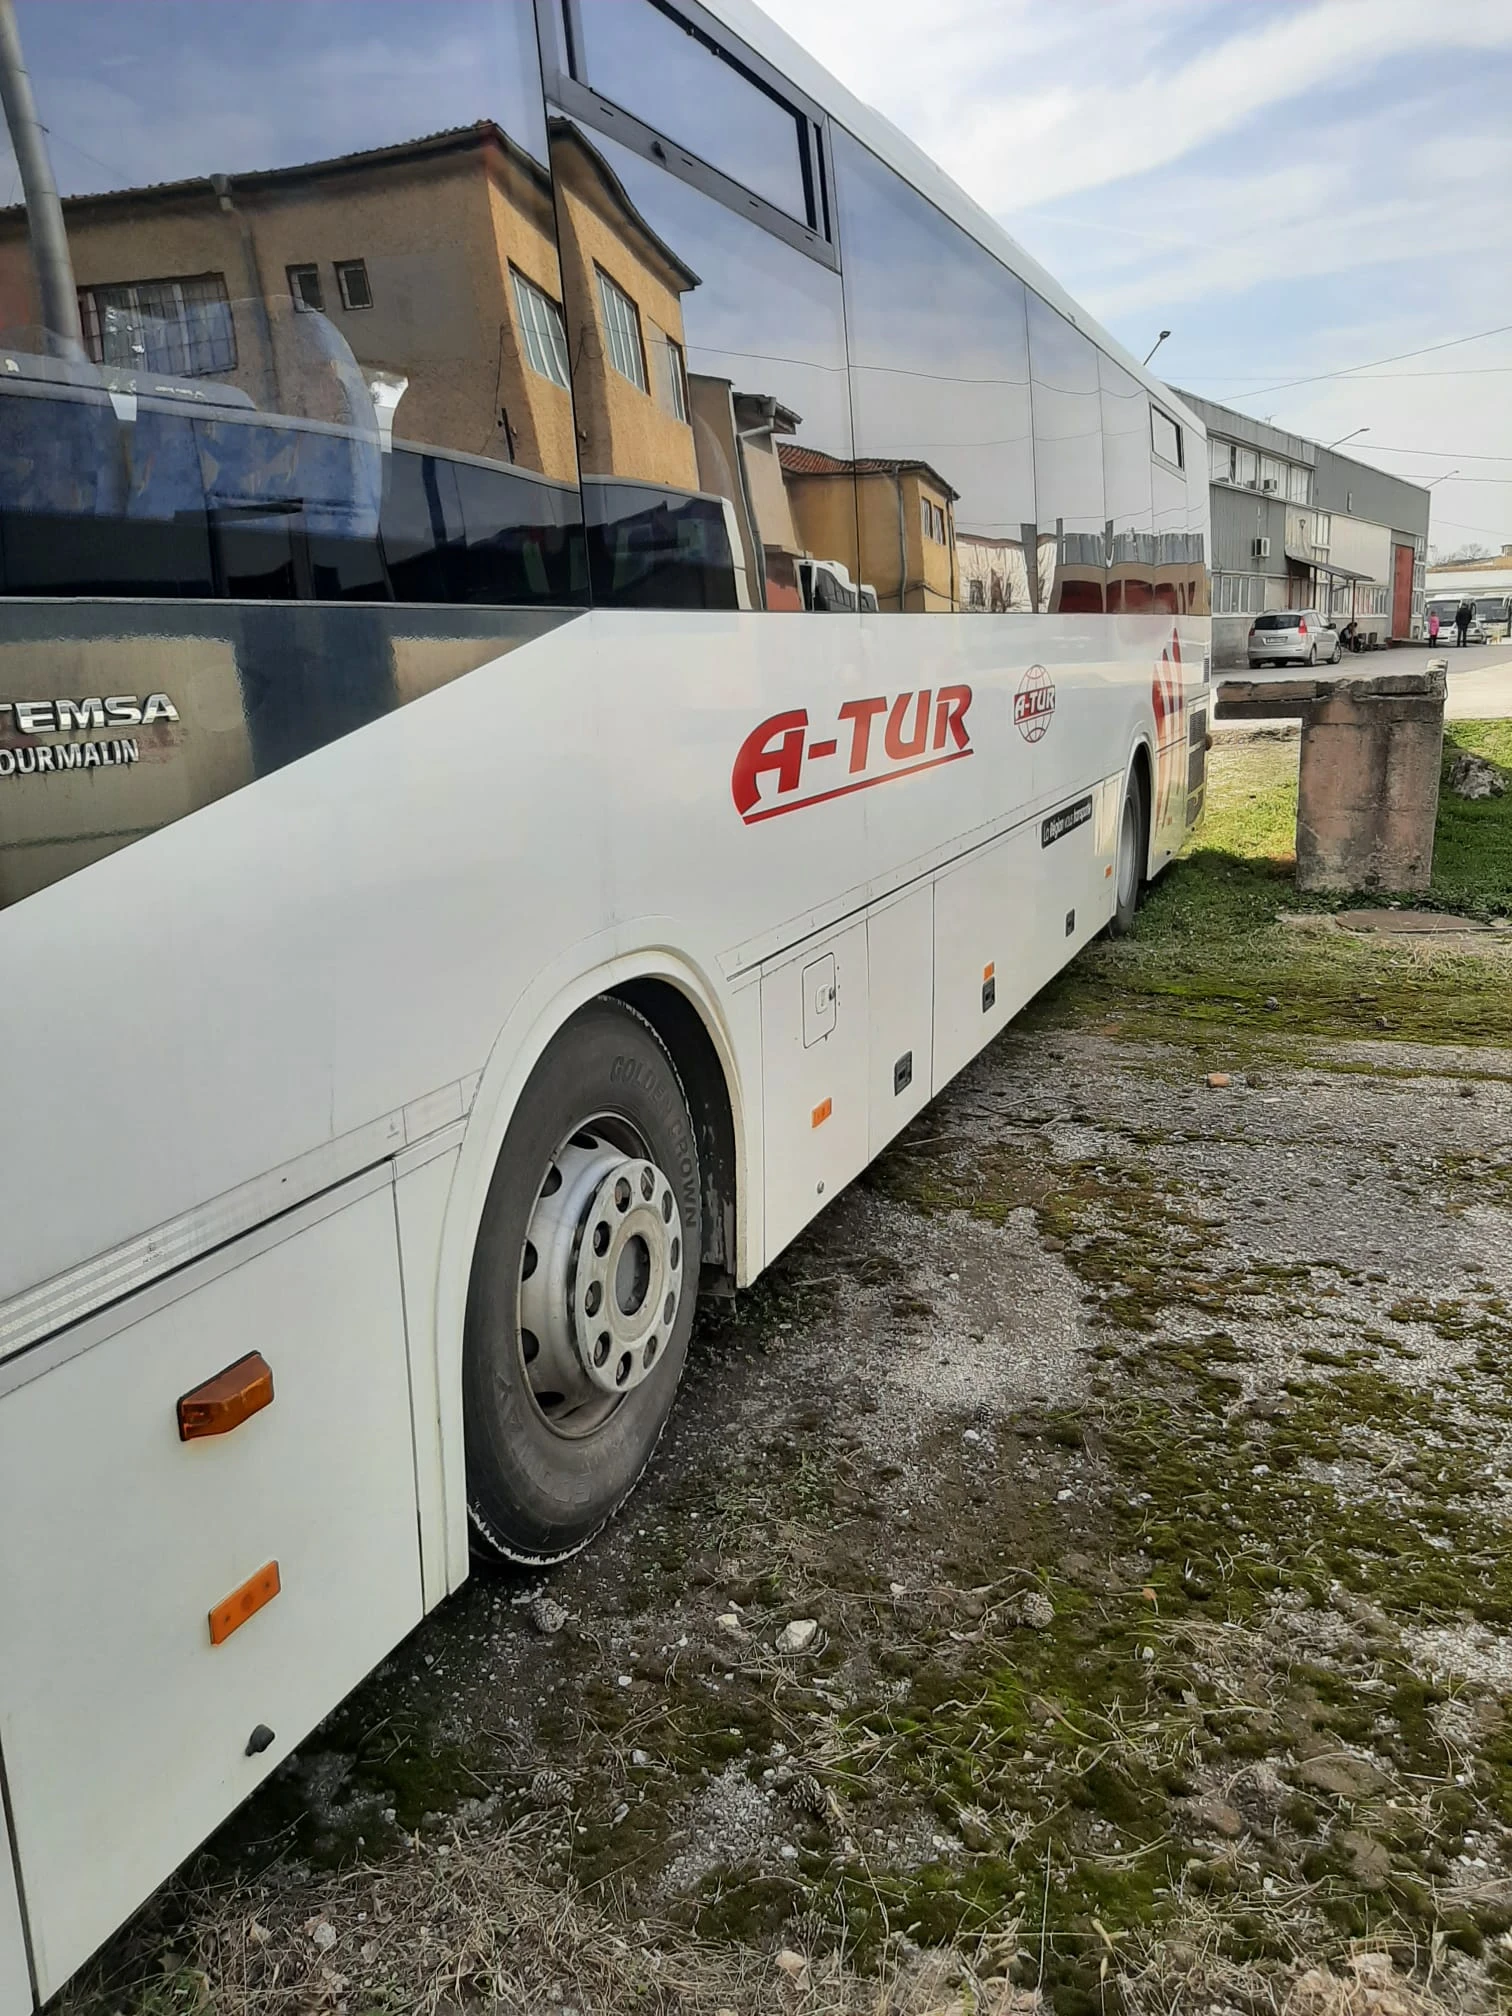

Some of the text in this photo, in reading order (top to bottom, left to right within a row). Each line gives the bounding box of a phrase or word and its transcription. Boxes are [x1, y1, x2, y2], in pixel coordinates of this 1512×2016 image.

[731, 683, 973, 816] A-TUR
[1014, 686, 1055, 721] A-TUR
[670, 1118, 698, 1229] CROWN
